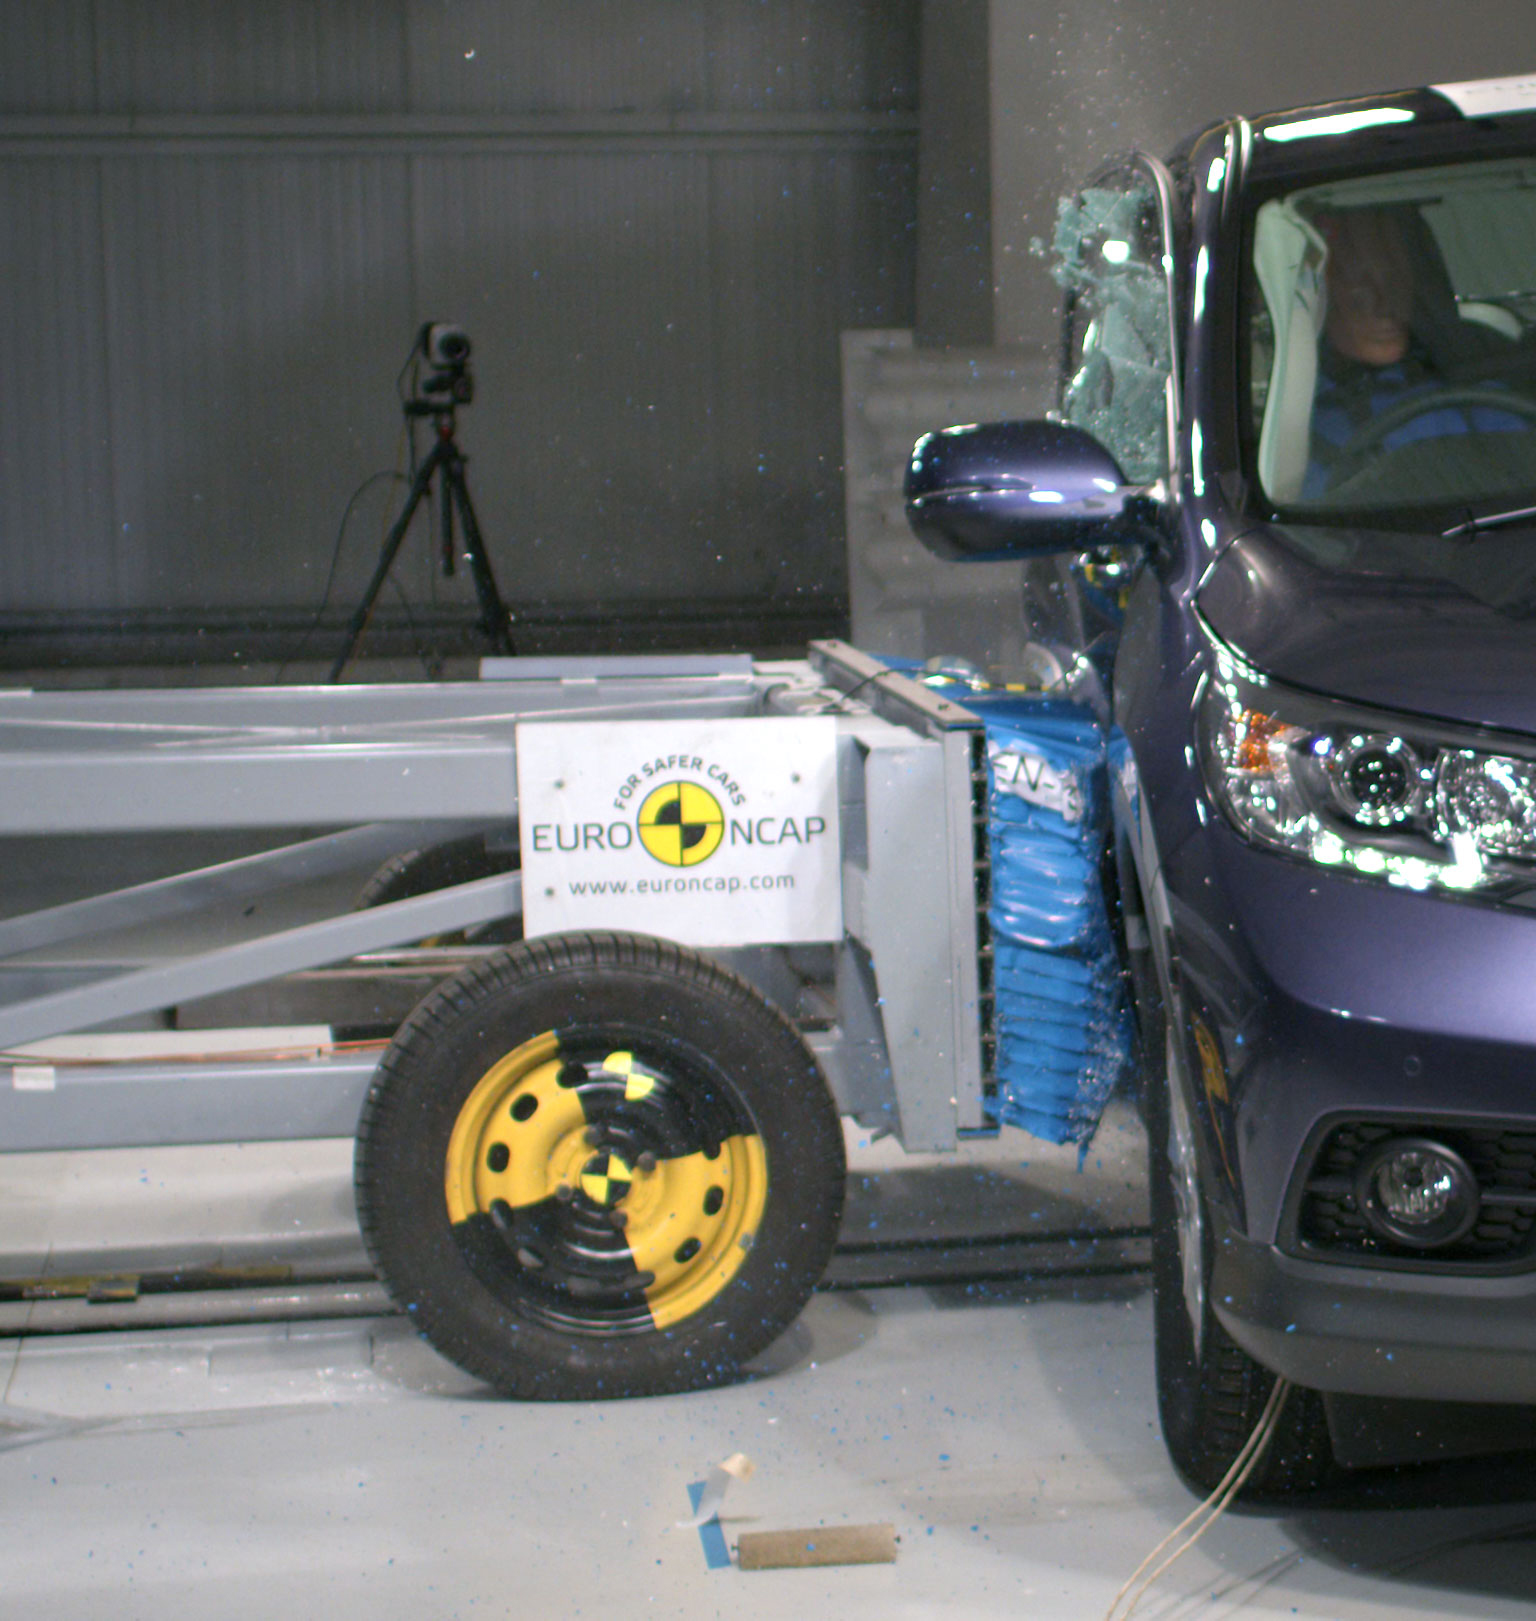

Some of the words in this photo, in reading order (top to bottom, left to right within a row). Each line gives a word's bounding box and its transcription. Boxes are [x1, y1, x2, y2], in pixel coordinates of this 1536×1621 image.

[613, 773, 642, 811] FOR
[641, 754, 703, 778] SAFER
[707, 763, 746, 807] CARS
[532, 821, 633, 852] EURO
[730, 816, 826, 846] NCAP
[568, 874, 795, 896] www.euroncap.com
